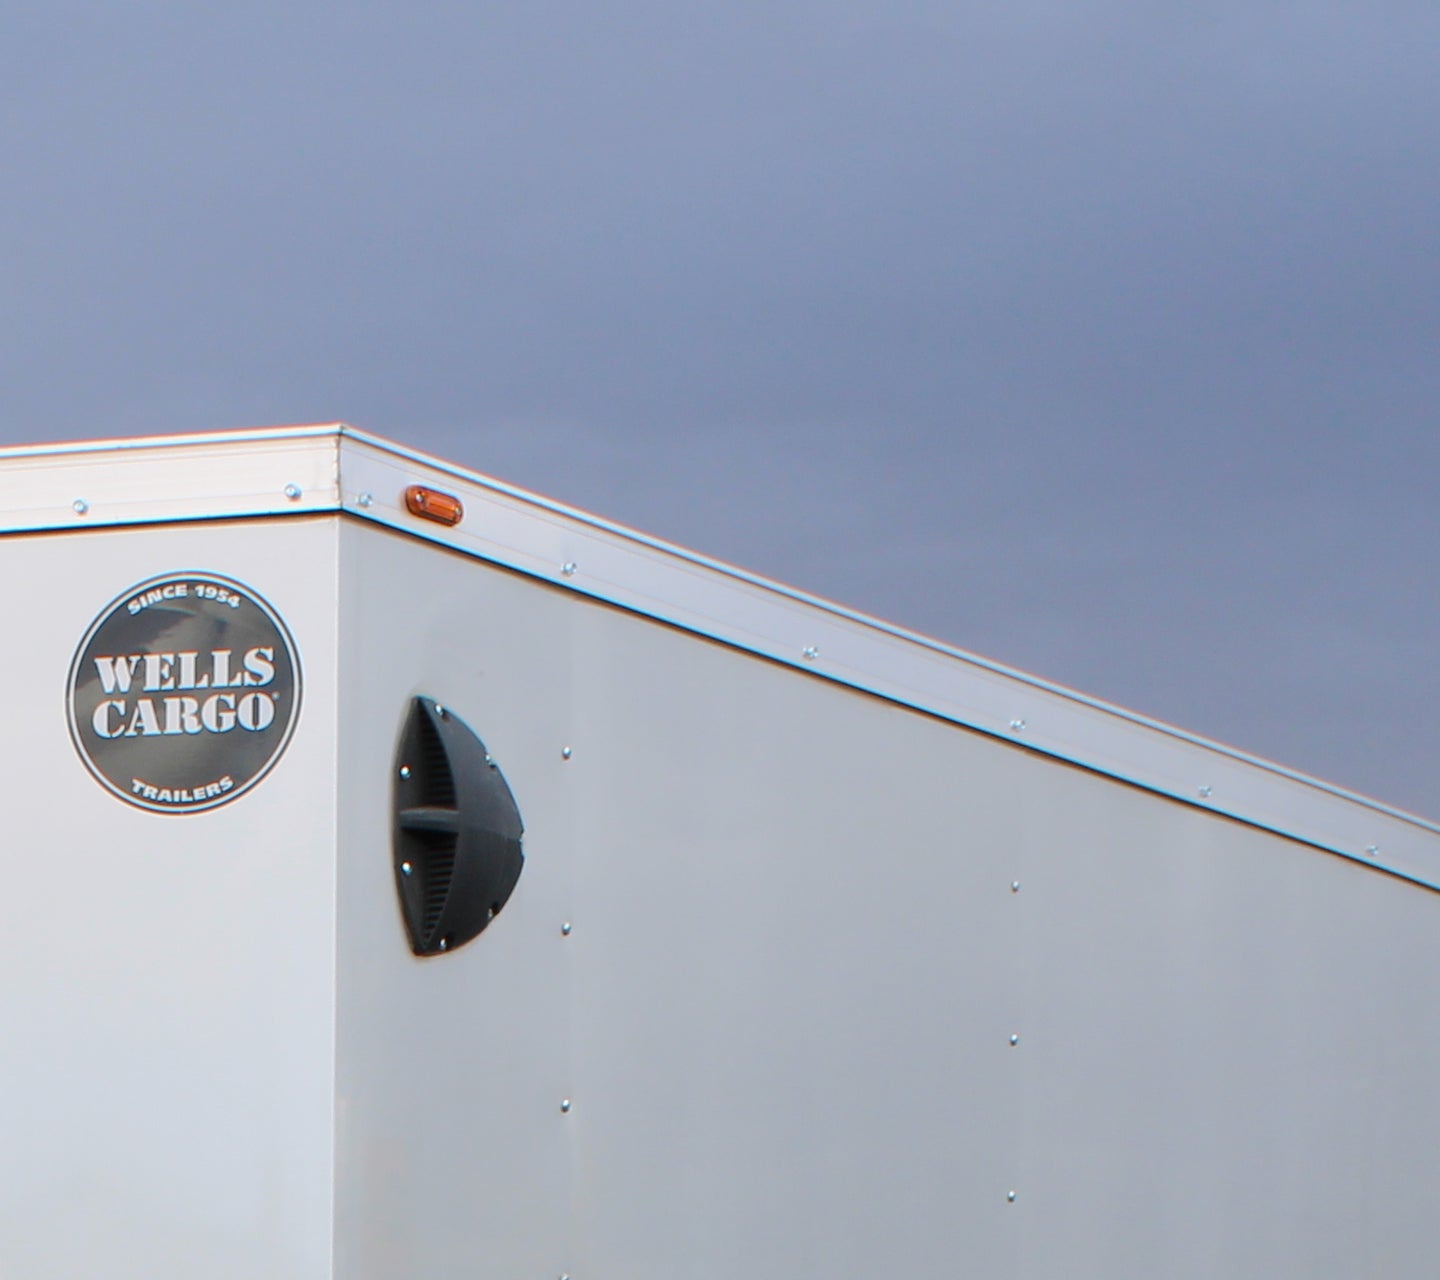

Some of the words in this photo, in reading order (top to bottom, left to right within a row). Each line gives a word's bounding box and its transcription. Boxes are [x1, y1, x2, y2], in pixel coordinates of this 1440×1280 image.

[127, 584, 188, 615] SINCE
[195, 584, 241, 609] 1954
[93, 646, 276, 694] WELLS
[92, 692, 276, 739] CARGO
[131, 775, 235, 803] TRAILERS
